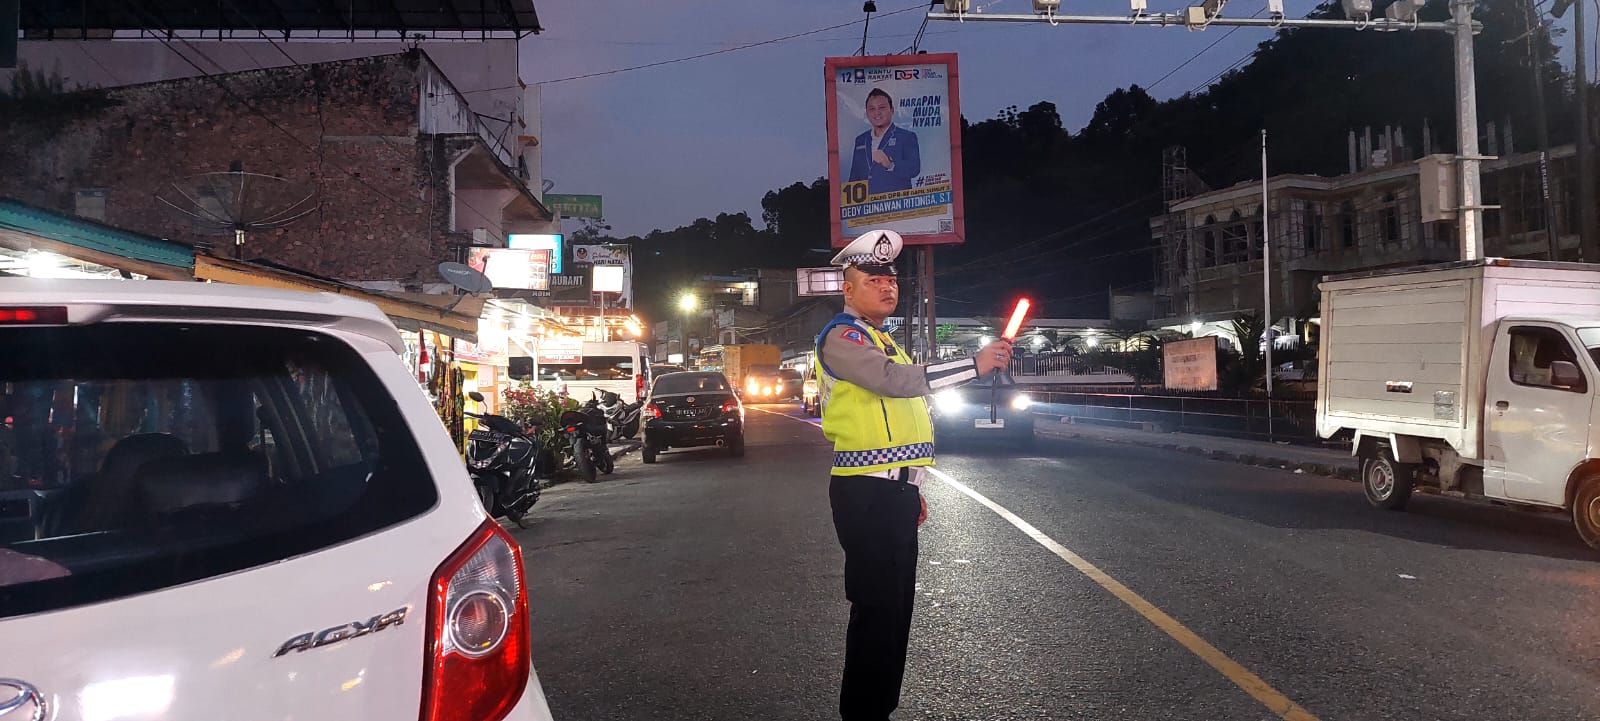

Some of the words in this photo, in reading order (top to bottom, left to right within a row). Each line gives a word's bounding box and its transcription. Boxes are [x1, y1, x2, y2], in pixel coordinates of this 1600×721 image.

[842, 72, 852, 82] 12
[895, 69, 920, 80] DGR
[900, 95, 941, 107] HARAPAN
[913, 106, 940, 117] MUDA
[912, 116, 941, 127] NYATA
[843, 183, 866, 204] 10
[841, 205, 862, 218] DEDY
[863, 200, 901, 215] GUNAWAN
[552, 275, 584, 286] AURANT
[271, 605, 409, 658] AGYA
